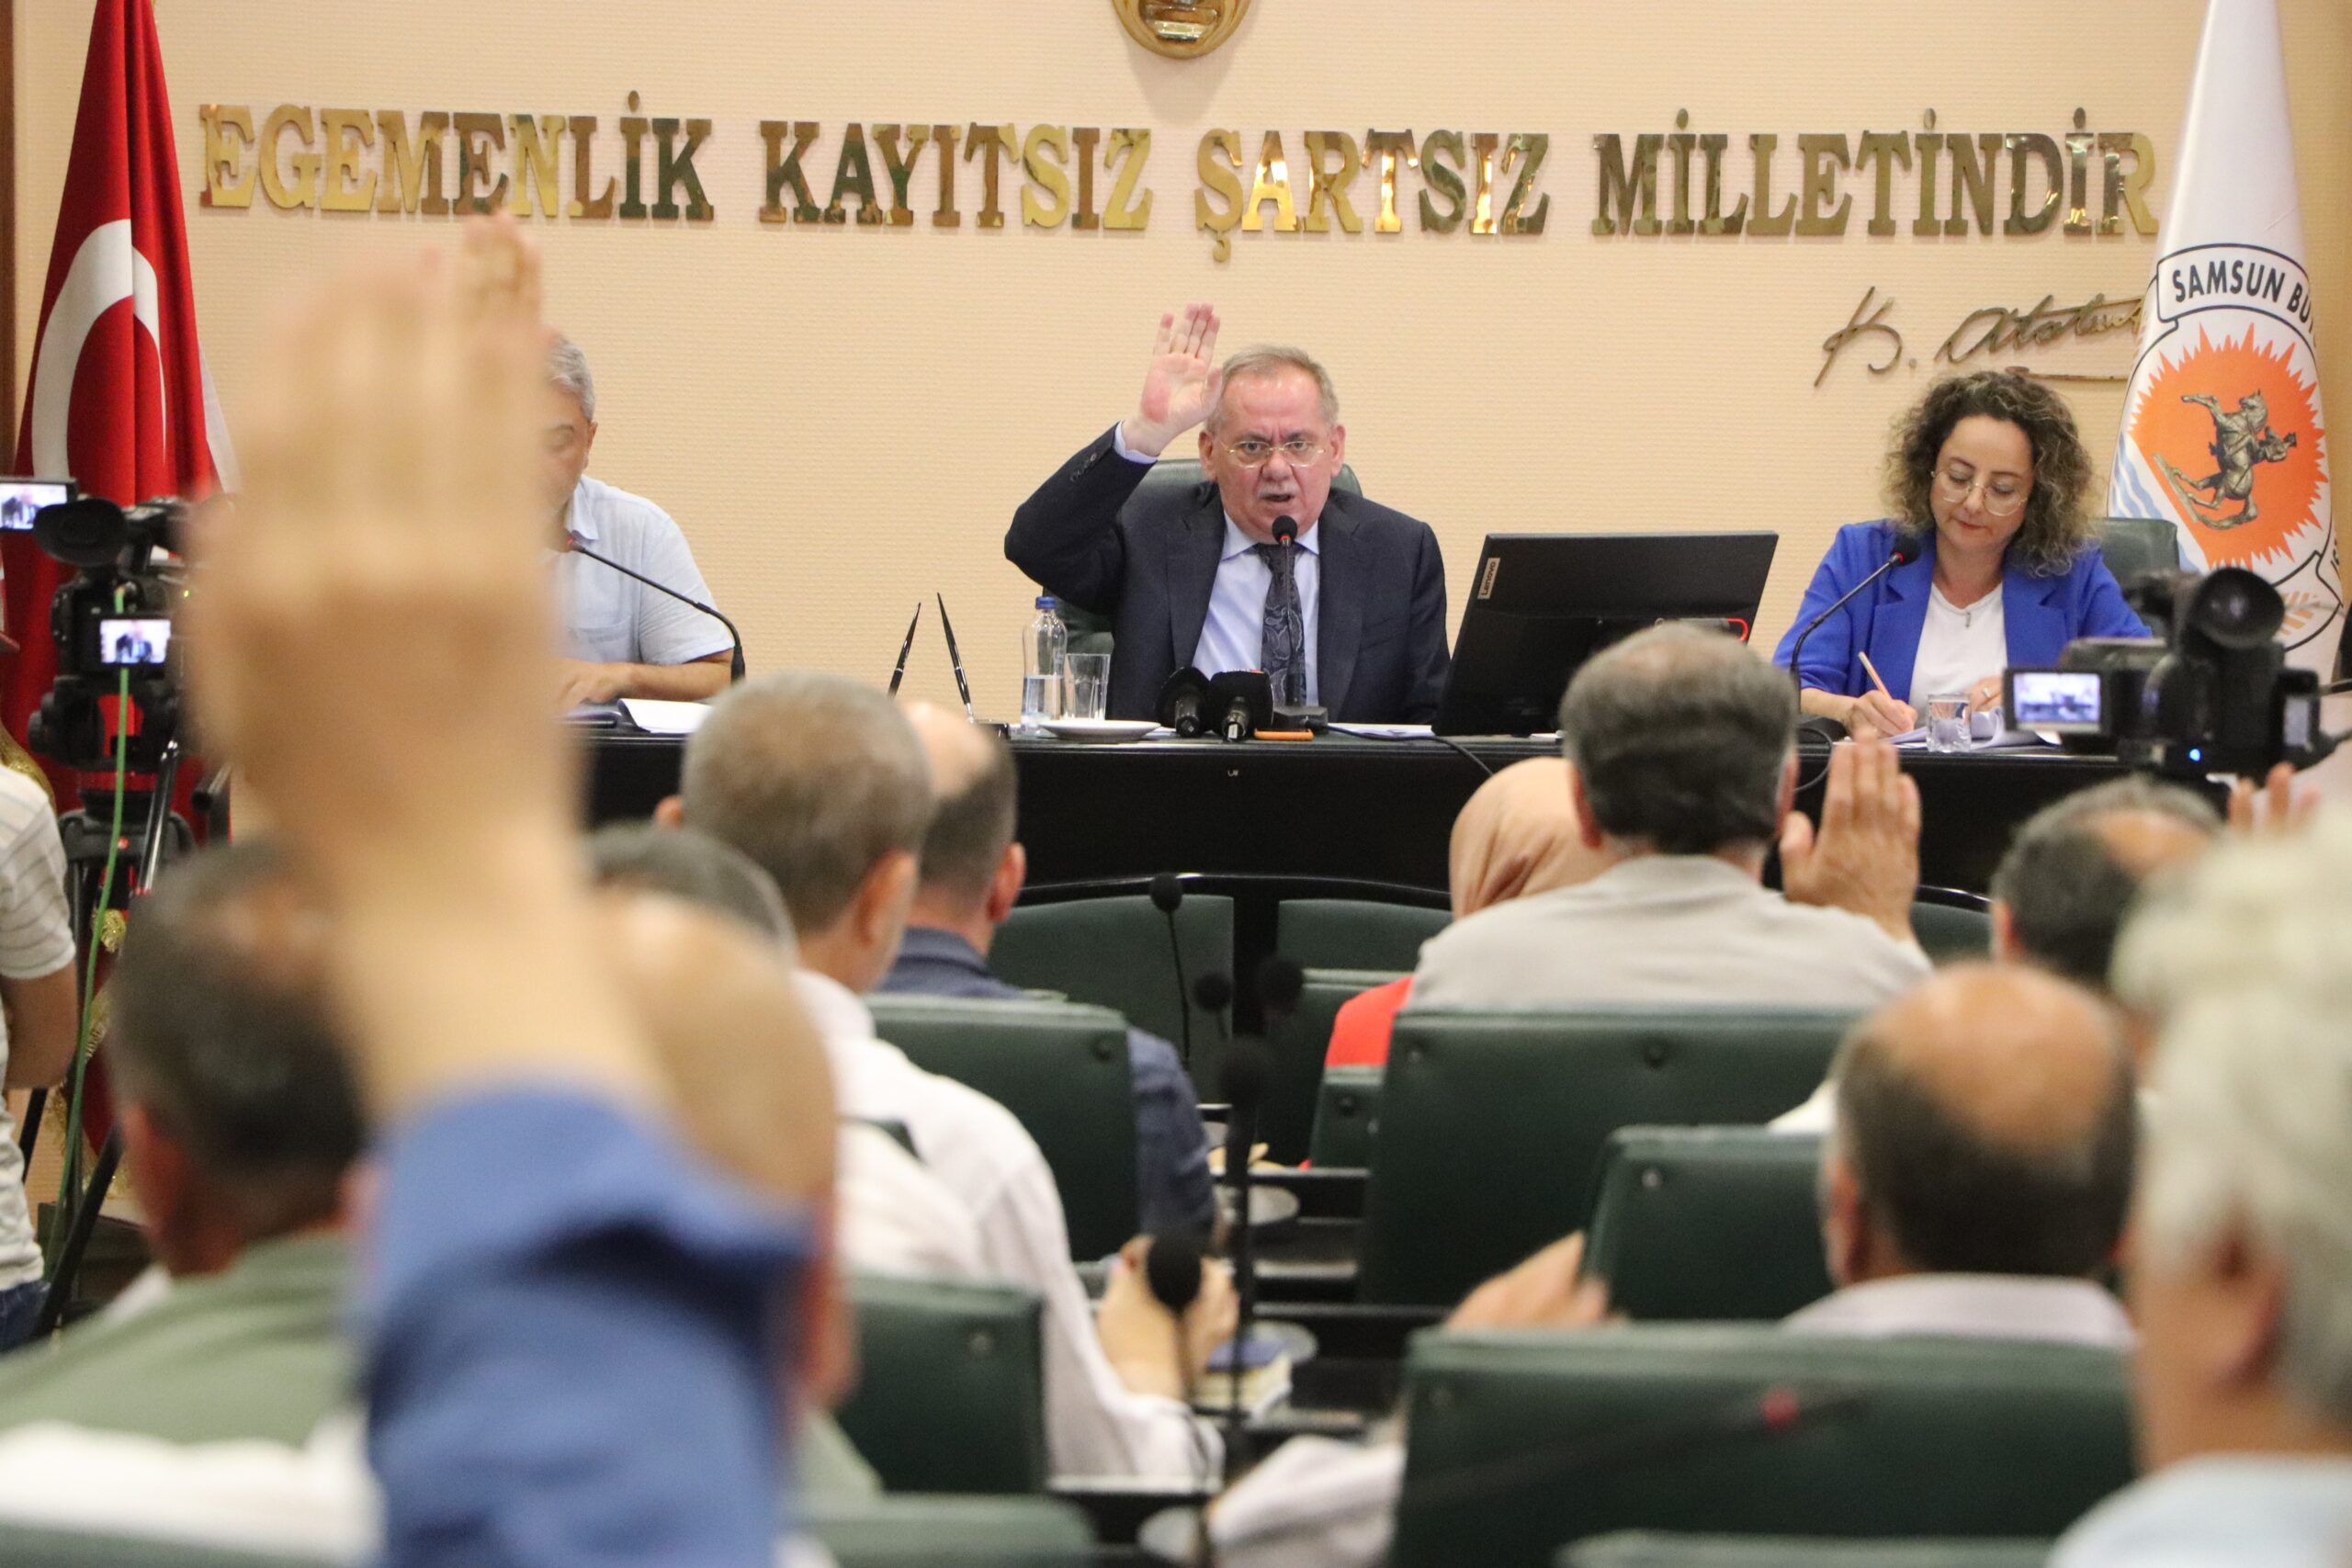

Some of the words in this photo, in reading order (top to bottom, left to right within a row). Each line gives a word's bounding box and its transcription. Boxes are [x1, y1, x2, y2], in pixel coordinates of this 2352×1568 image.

[199, 89, 715, 220] EGEMENLİK
[759, 120, 1153, 231] KAYITSIZ
[1194, 128, 1550, 263] ŞARTSIZ
[1592, 107, 2160, 236] MİLLETİNDİR
[2173, 260, 2286, 303] SAMSUN
[1481, 561, 1497, 595] Lenovo
